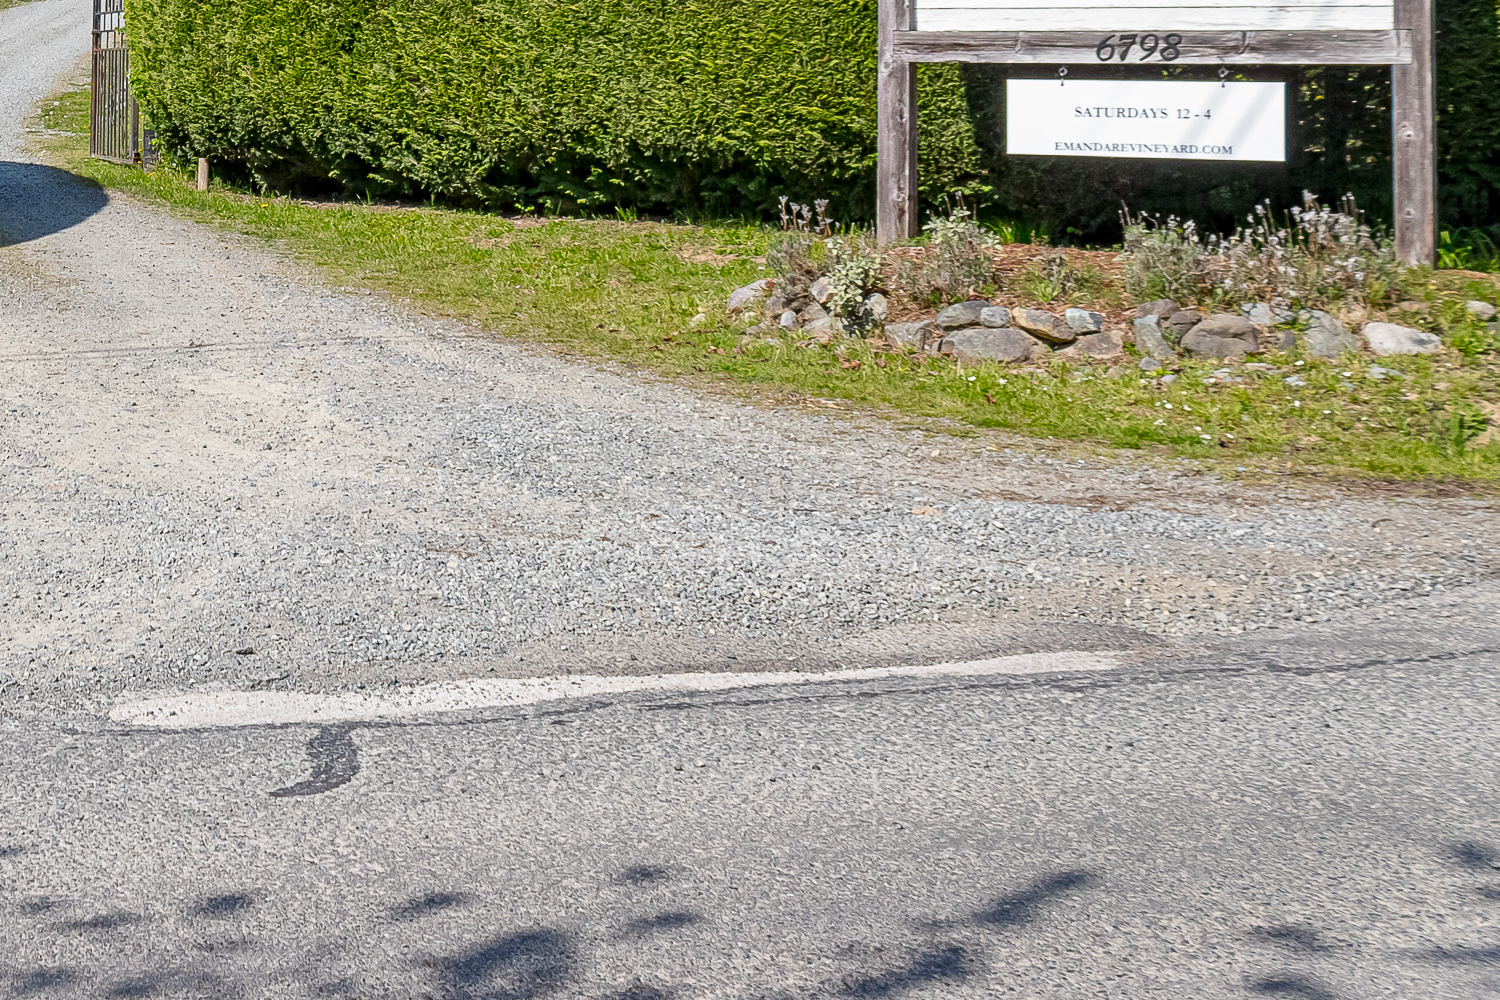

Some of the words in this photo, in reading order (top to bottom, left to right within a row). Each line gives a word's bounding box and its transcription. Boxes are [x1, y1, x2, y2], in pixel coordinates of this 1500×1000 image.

[1096, 33, 1183, 62] 6798
[1074, 106, 1169, 119] SATURDAYS
[1054, 141, 1234, 155] EMANDAREVINEYARD.COM
